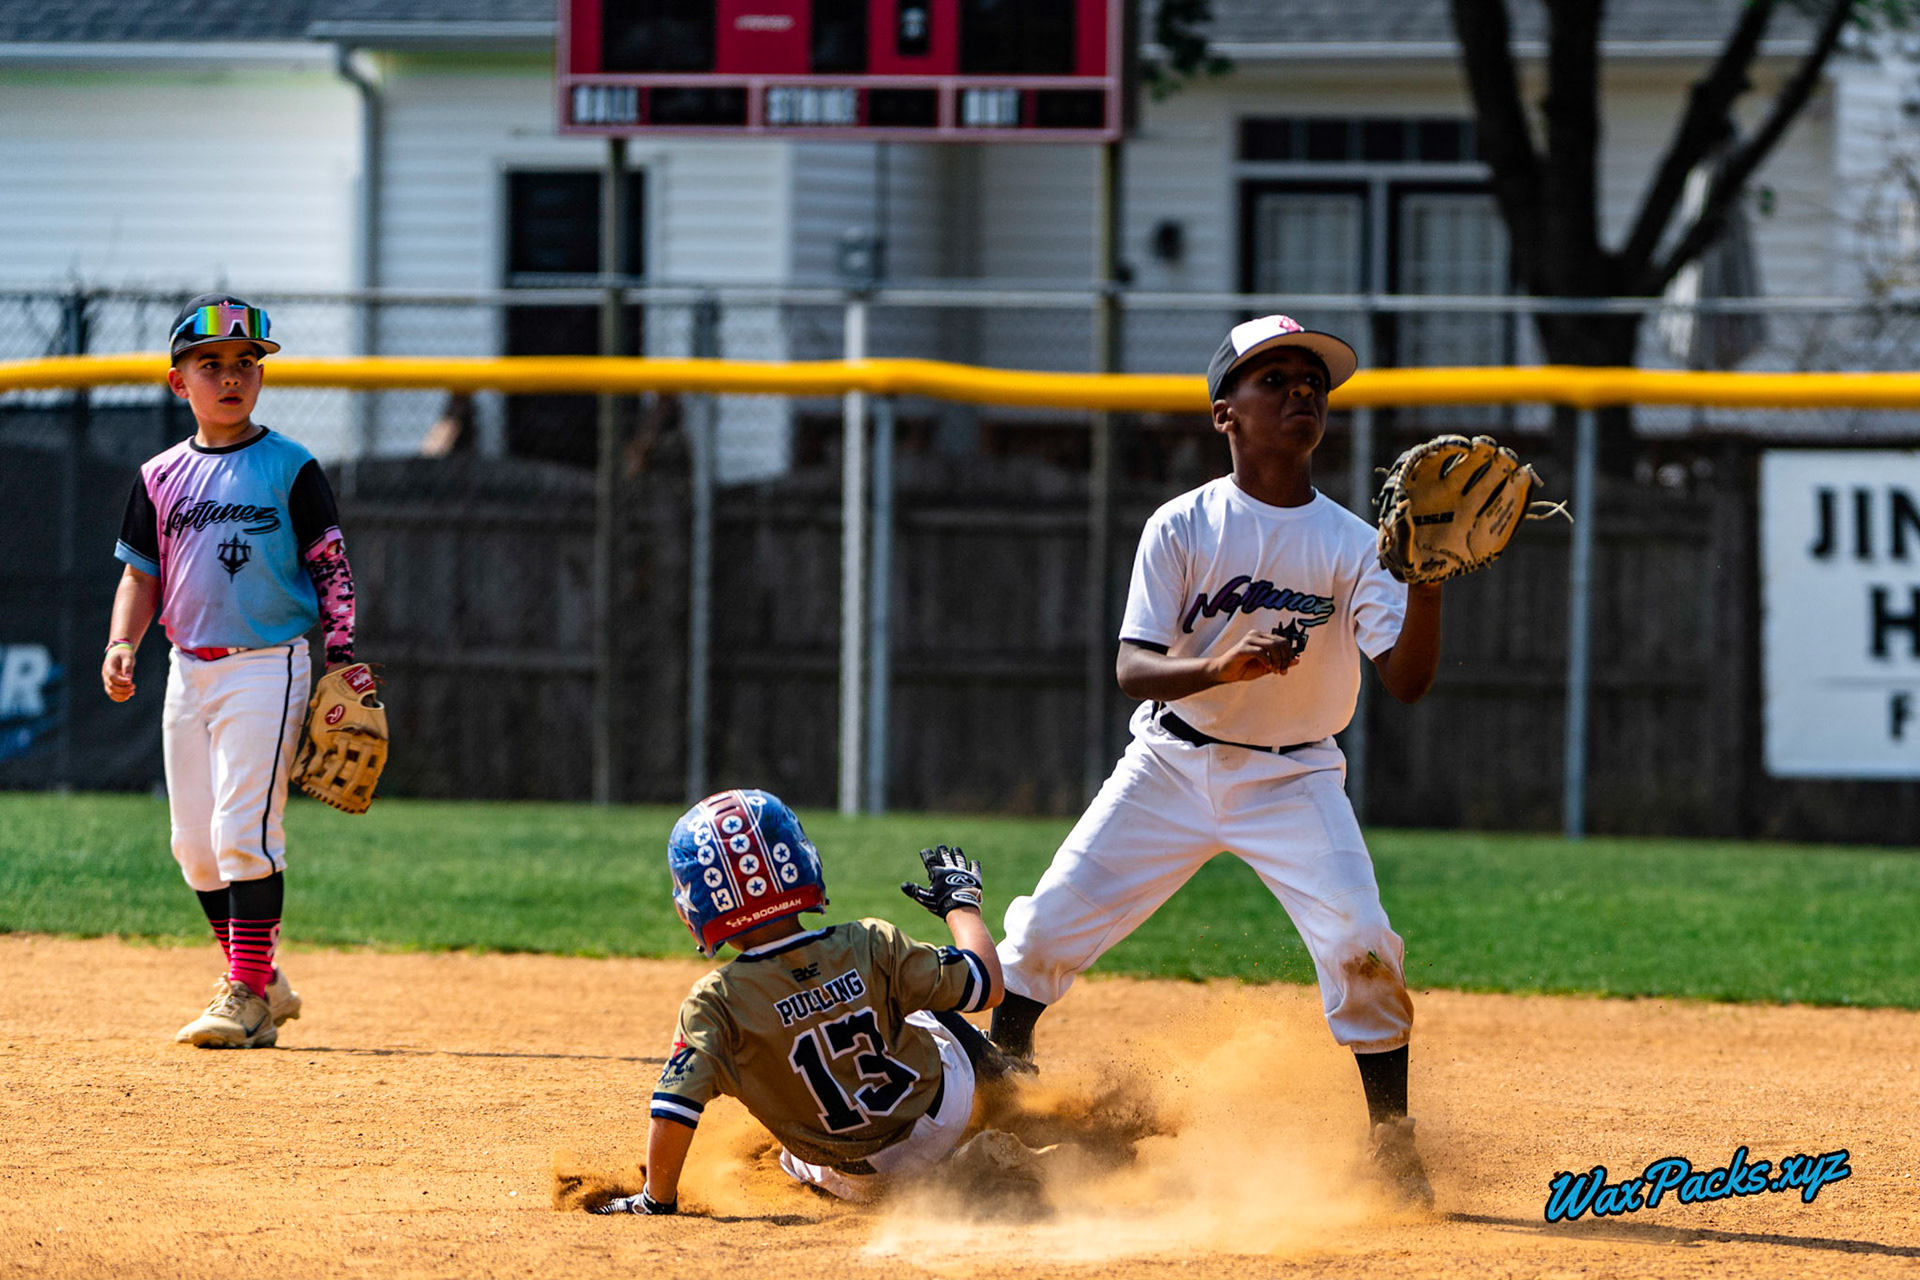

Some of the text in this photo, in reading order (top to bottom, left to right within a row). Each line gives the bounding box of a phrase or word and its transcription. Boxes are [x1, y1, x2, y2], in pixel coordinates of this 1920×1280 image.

[711, 888, 734, 912] 13
[752, 898, 802, 920] BOOMBAH
[774, 968, 867, 1028] PULLING
[788, 1006, 920, 1134] 13
